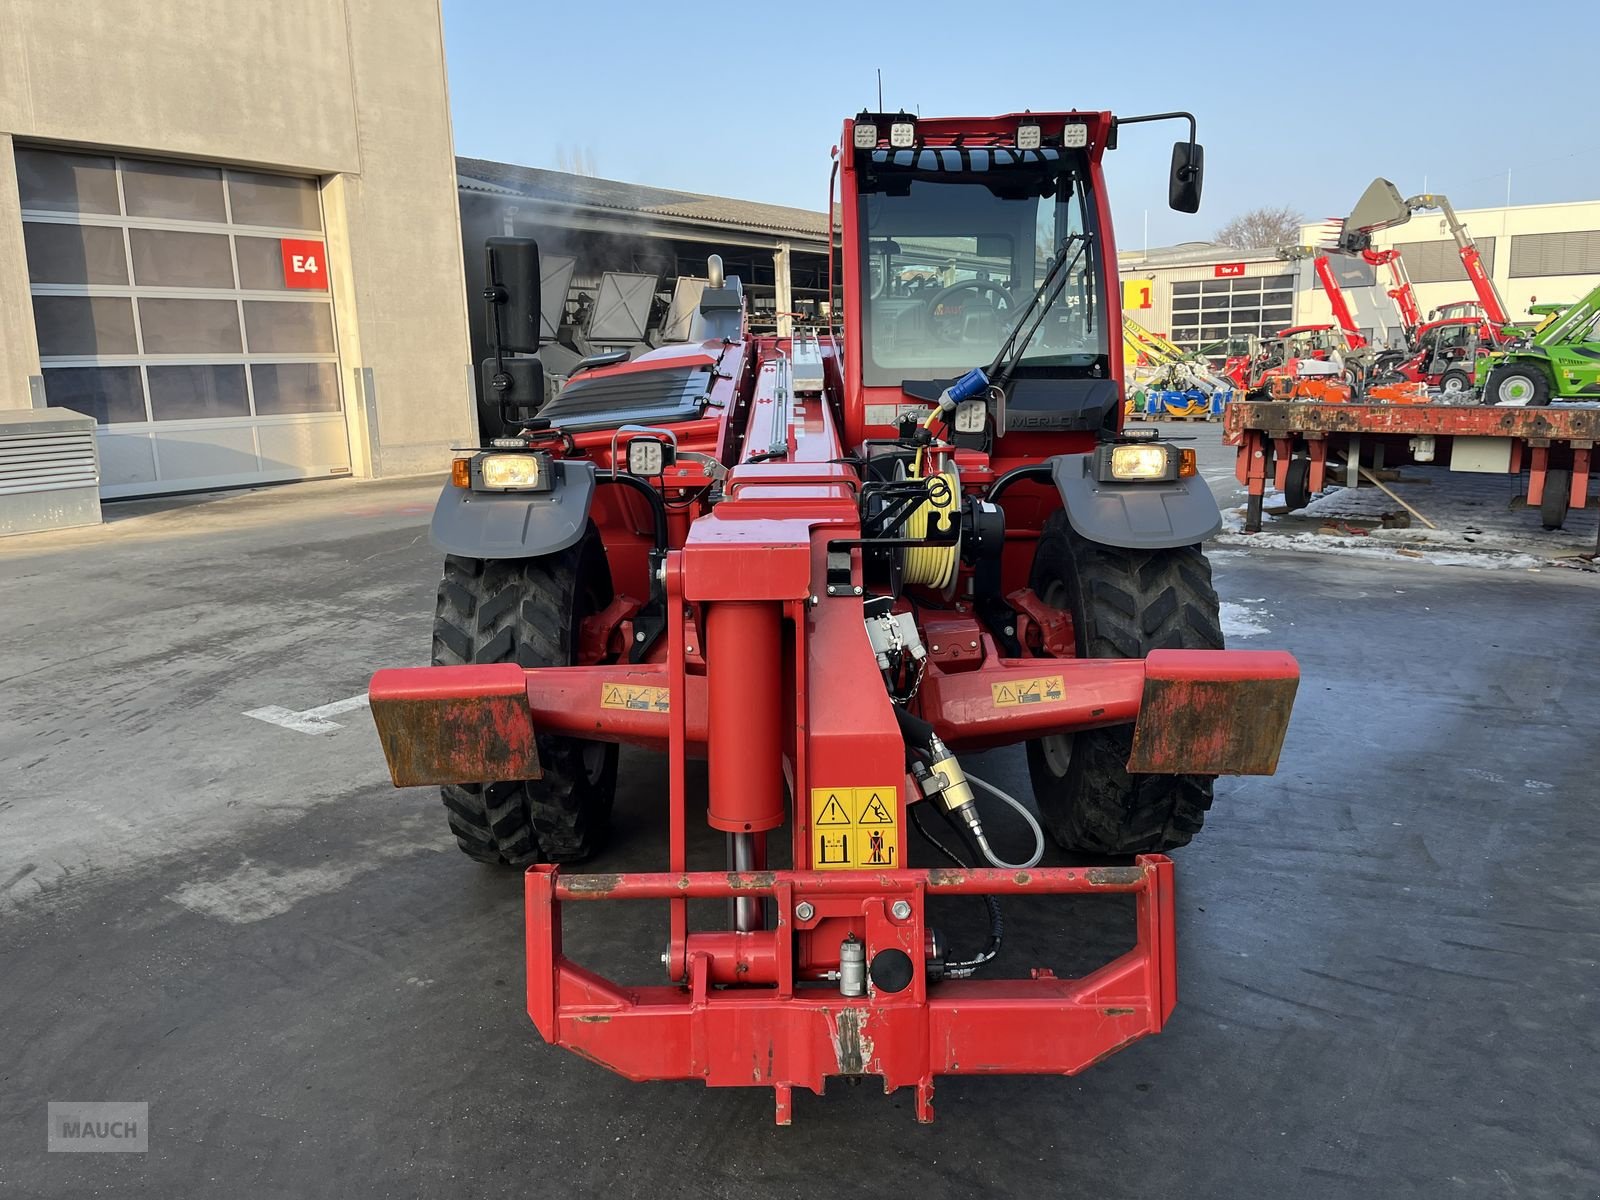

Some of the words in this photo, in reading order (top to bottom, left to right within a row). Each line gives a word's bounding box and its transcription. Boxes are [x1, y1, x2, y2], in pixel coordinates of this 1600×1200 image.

[292, 255, 318, 273] E4
[1140, 287, 1152, 309] 1
[1011, 415, 1073, 428] MERLO
